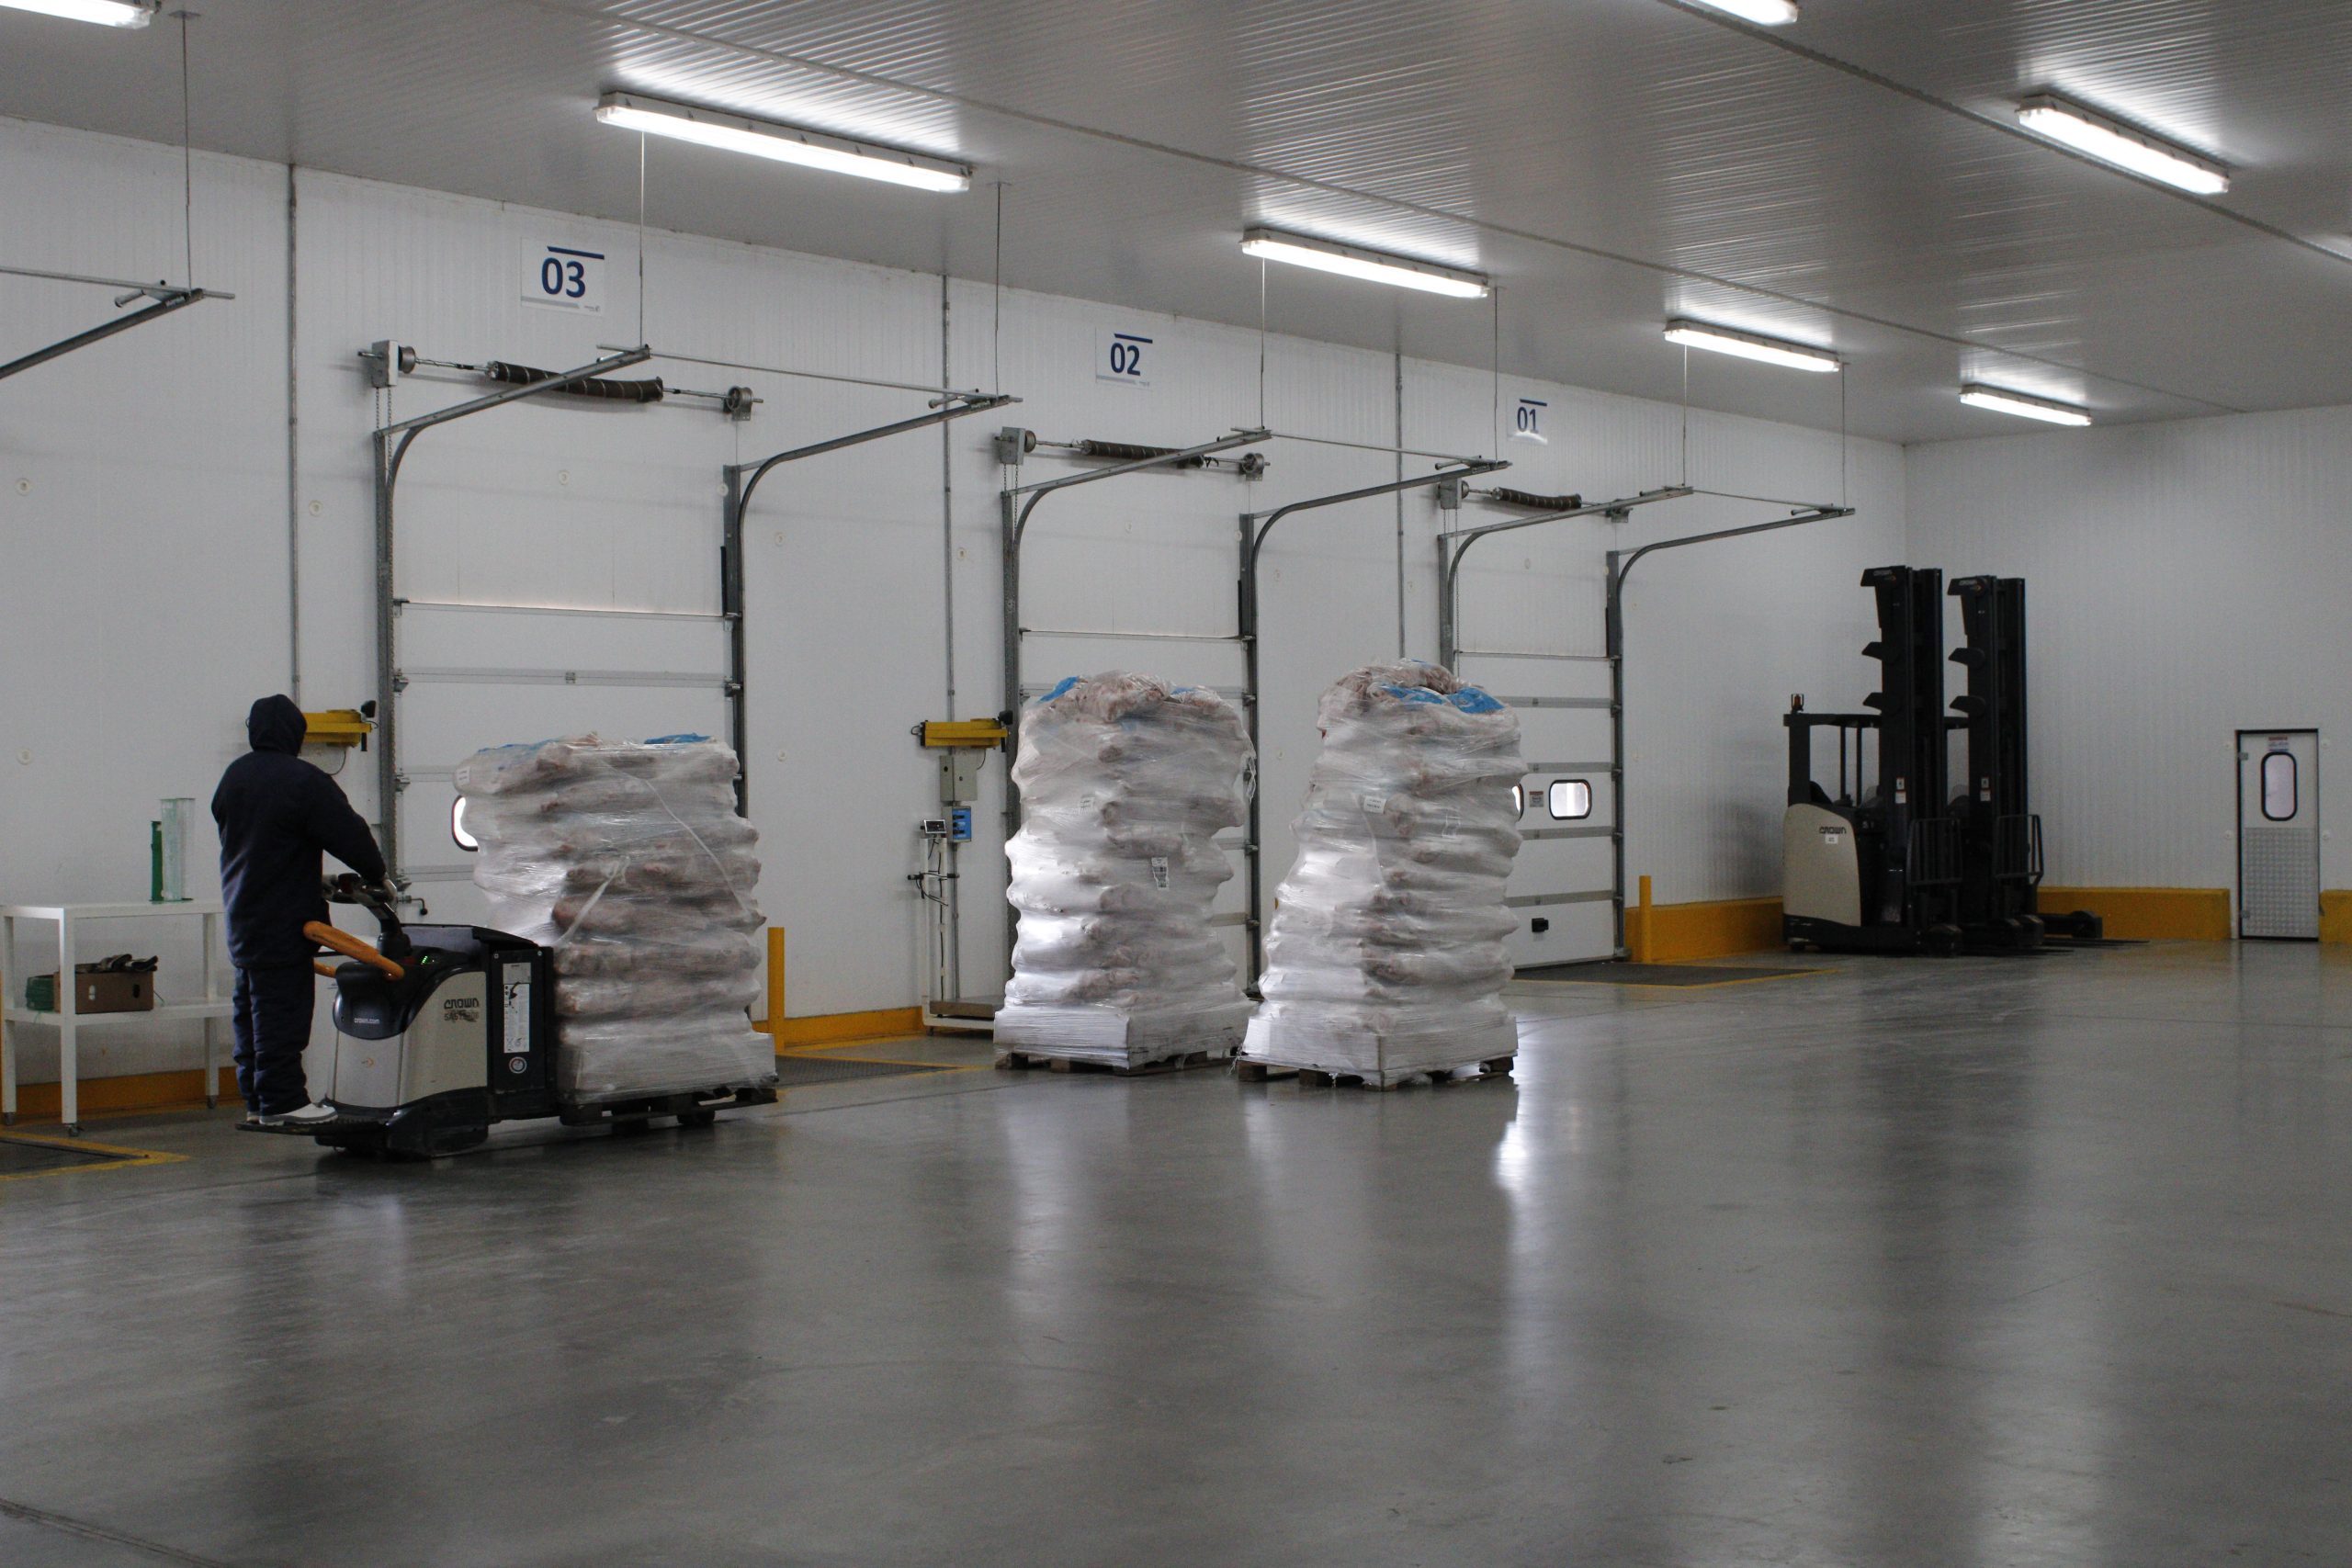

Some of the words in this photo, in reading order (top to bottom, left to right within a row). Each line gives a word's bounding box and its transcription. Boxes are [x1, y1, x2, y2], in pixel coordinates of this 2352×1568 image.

[542, 257, 585, 298] 03
[1111, 343, 1141, 376] 02
[1518, 407, 1539, 434] 01
[1819, 826, 1847, 834] CROWN
[444, 998, 479, 1010] CROWN
